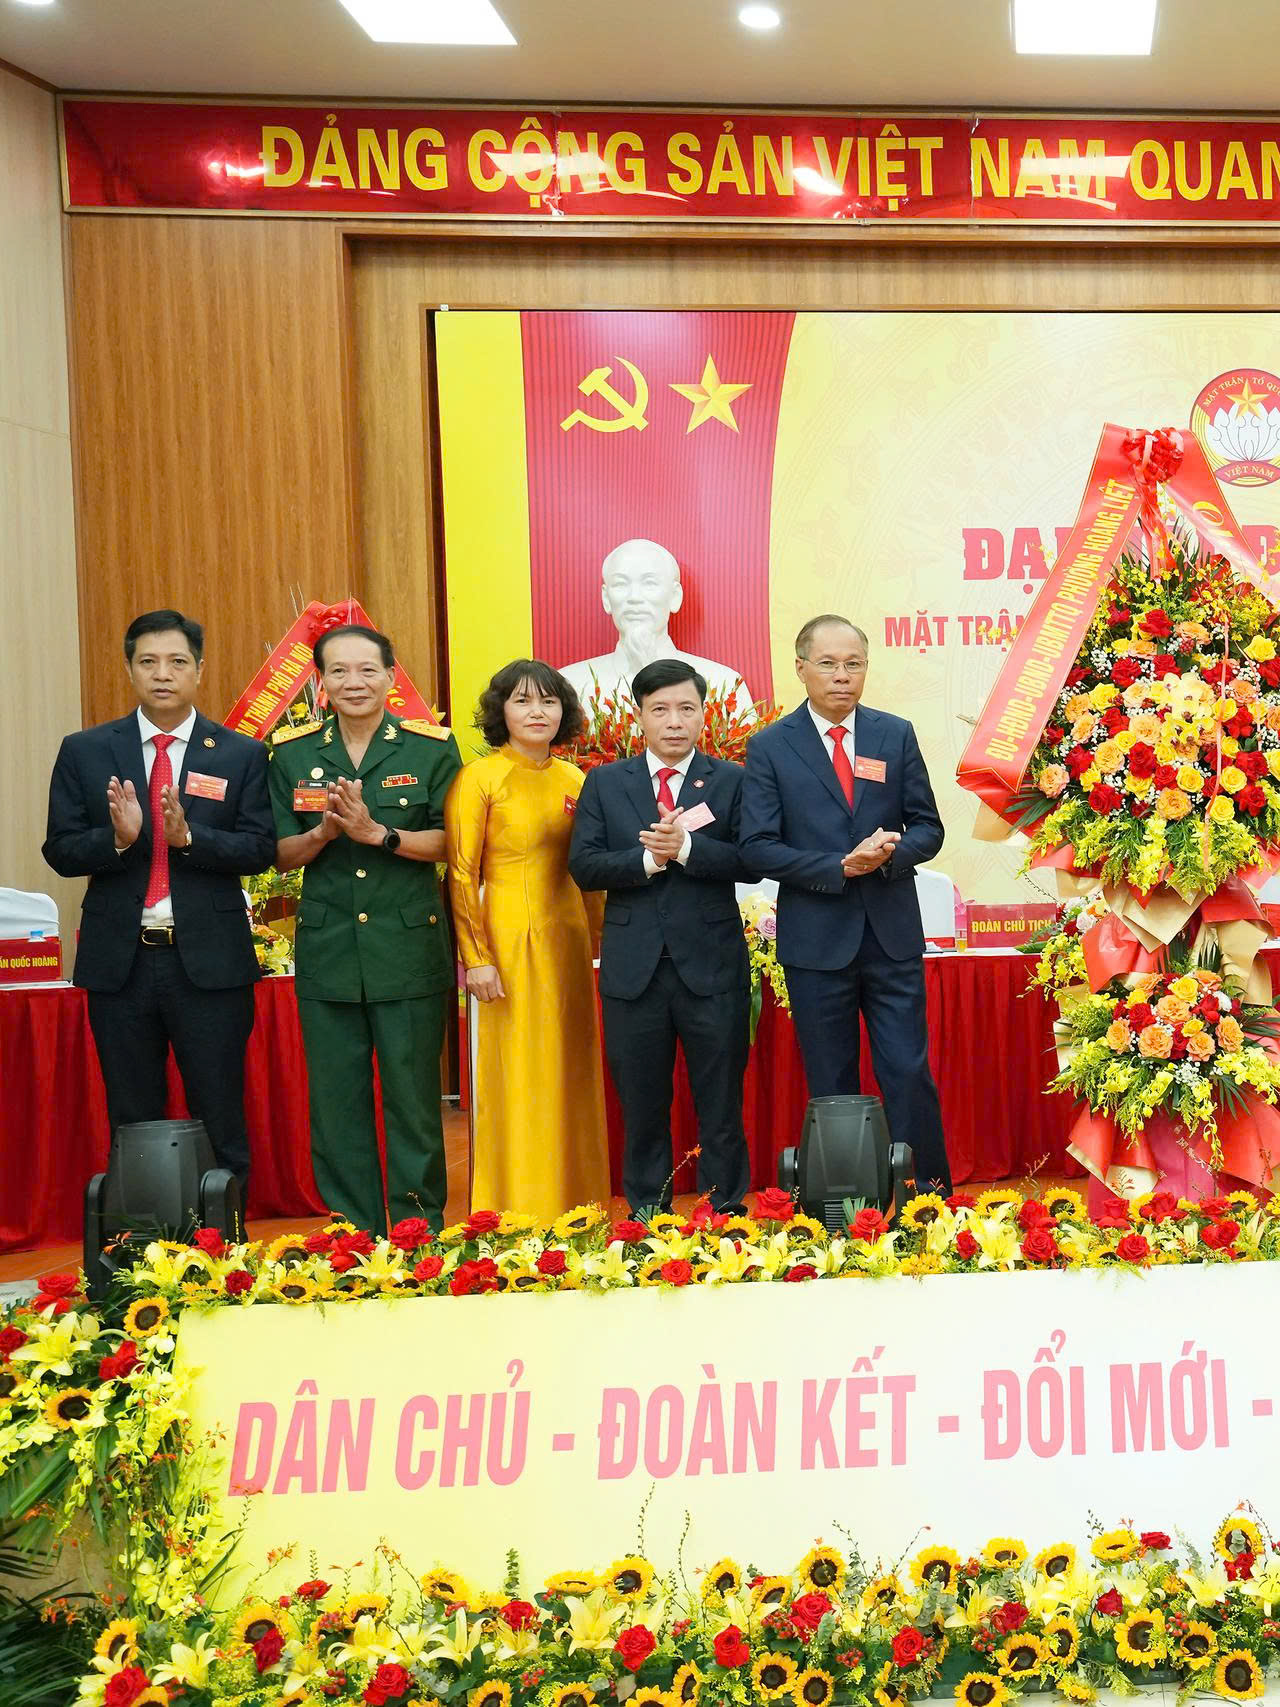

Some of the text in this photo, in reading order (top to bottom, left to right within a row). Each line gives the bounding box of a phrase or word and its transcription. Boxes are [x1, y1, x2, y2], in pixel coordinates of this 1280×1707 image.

[259, 114, 449, 191] ĐẢNG
[467, 117, 646, 208] CỘNG
[666, 121, 793, 196] SẢN
[813, 123, 943, 211] VIỆT
[971, 138, 1107, 199] NAM
[1224, 465, 1275, 479] VIỆT NAM
[1098, 478, 1139, 511] LIỆT
[1082, 511, 1124, 552] HOÀNG
[885, 609, 949, 653] MẶT
[244, 690, 281, 724] THÀNH
[266, 665, 294, 697] PHỐ
[280, 656, 304, 678] HÀ
[971, 918, 1001, 933] ĐOÀN
[1004, 916, 1026, 933] CHỦ
[10, 954, 31, 968] QUỐC
[32, 955, 58, 967] HOÀNG
[227, 1379, 375, 1497] DÂN
[395, 1358, 531, 1491] CHỦ
[552, 1434, 575, 1452] -
[598, 1364, 778, 1480] ĐOÀN
[801, 1346, 916, 1471] KẾT
[938, 1416, 959, 1433] -
[981, 1329, 1086, 1460] ĐỔI
[1109, 1341, 1229, 1454] MỚI
[1252, 1399, 1273, 1416] -
